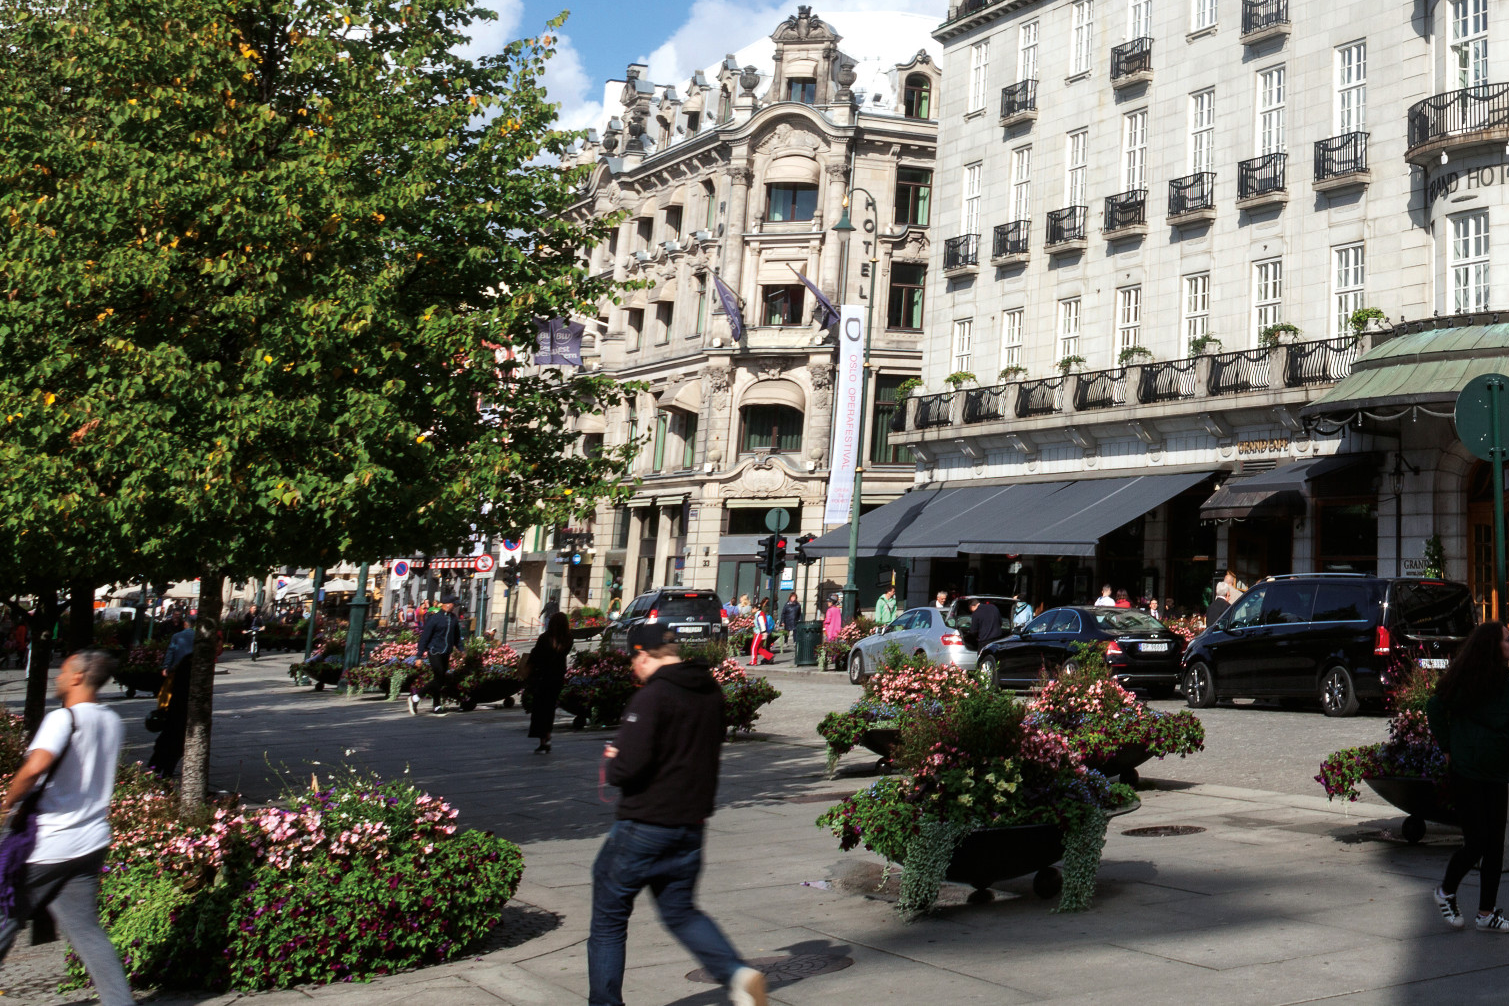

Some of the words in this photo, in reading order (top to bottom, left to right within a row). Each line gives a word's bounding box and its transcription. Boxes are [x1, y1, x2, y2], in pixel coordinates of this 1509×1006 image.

[859, 197, 876, 300] HOTEL
[849, 354, 857, 382] OSLO
[841, 387, 857, 470] OPERAFESTIVAL
[1237, 440, 1267, 451] GRAND
[702, 560, 710, 568] 33
